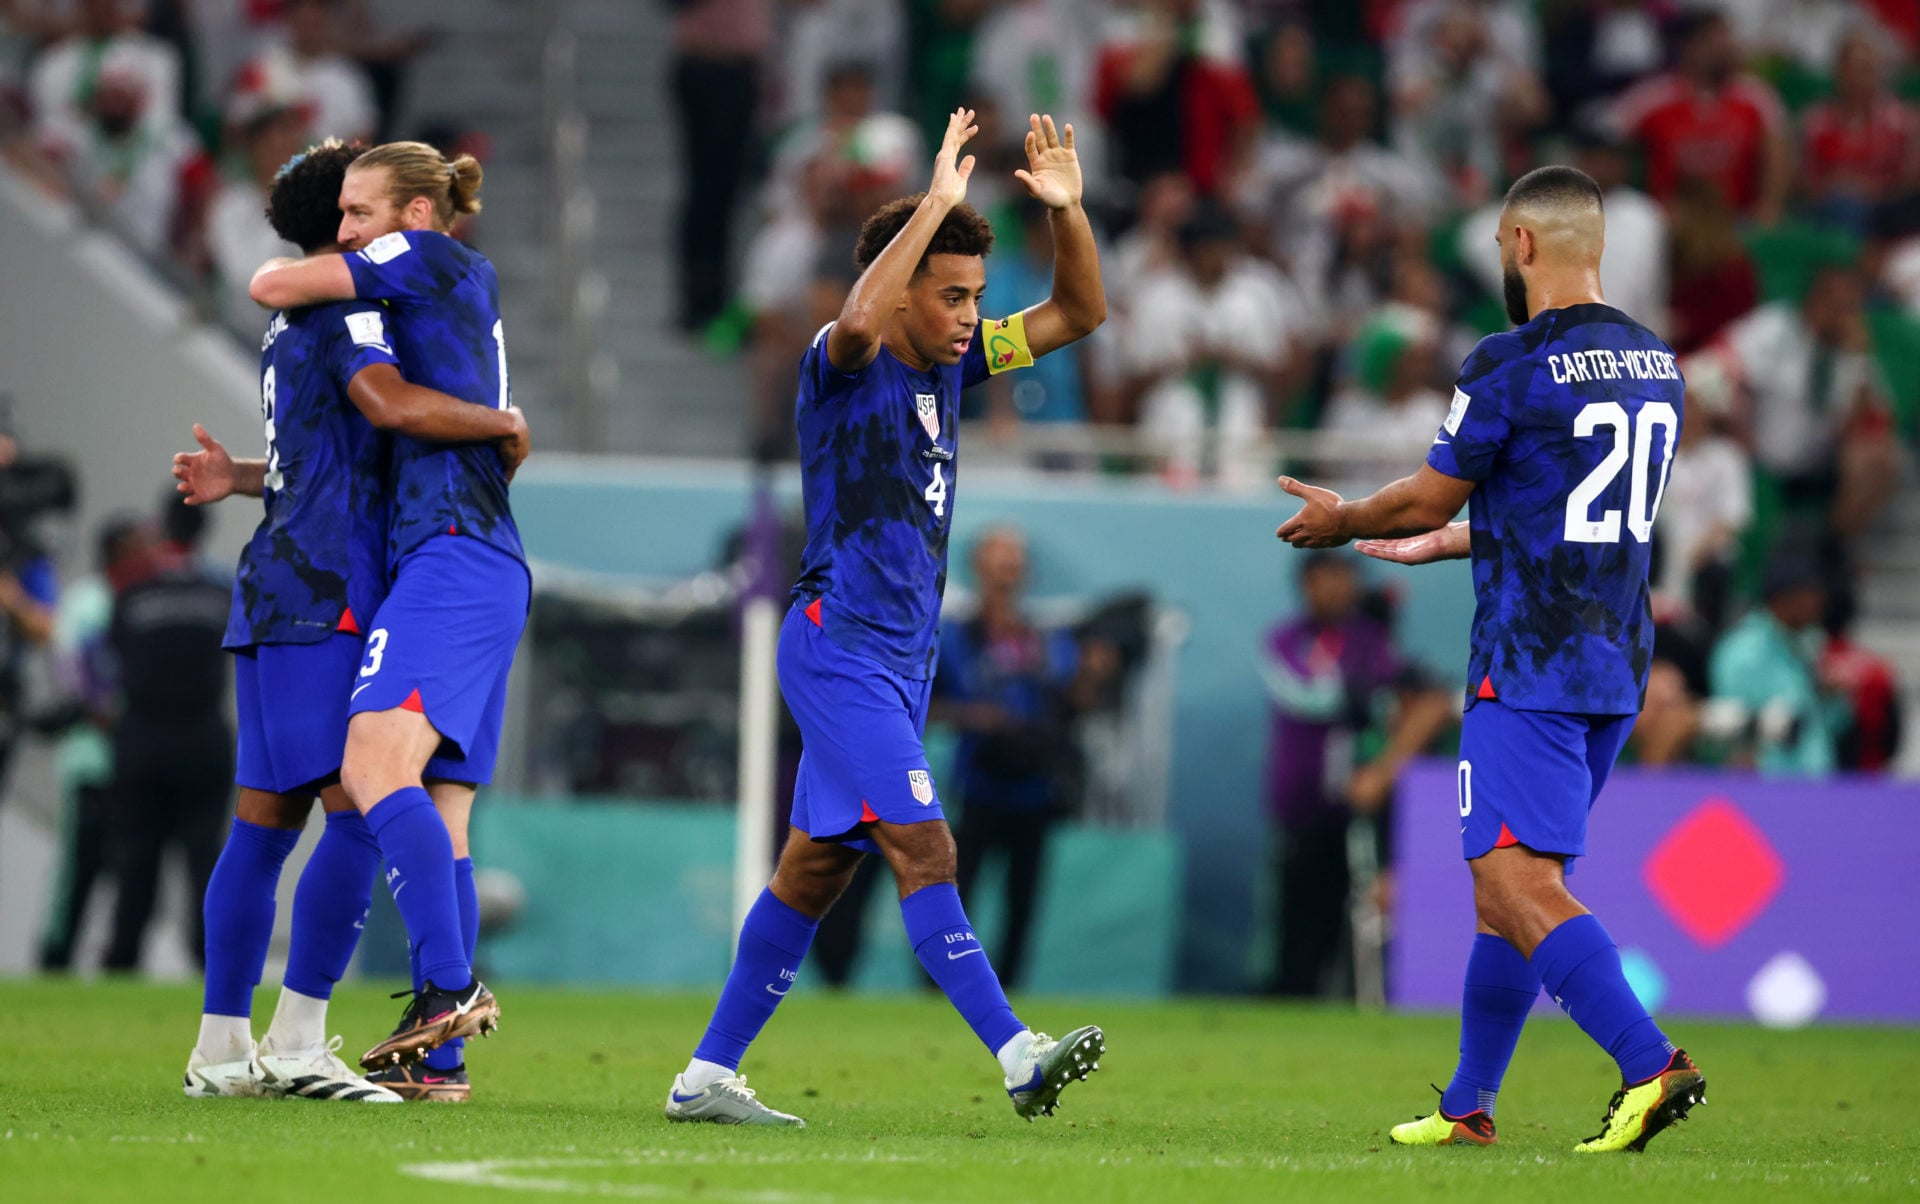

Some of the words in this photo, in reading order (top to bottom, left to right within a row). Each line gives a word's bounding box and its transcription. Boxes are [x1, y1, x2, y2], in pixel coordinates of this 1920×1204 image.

[918, 396, 935, 416] USA
[1564, 401, 1678, 543] 20
[925, 462, 946, 517] 4
[355, 628, 389, 681] 3
[910, 772, 928, 785] USA
[386, 867, 400, 885] SA
[944, 932, 976, 944] USA
[779, 968, 798, 982] US
